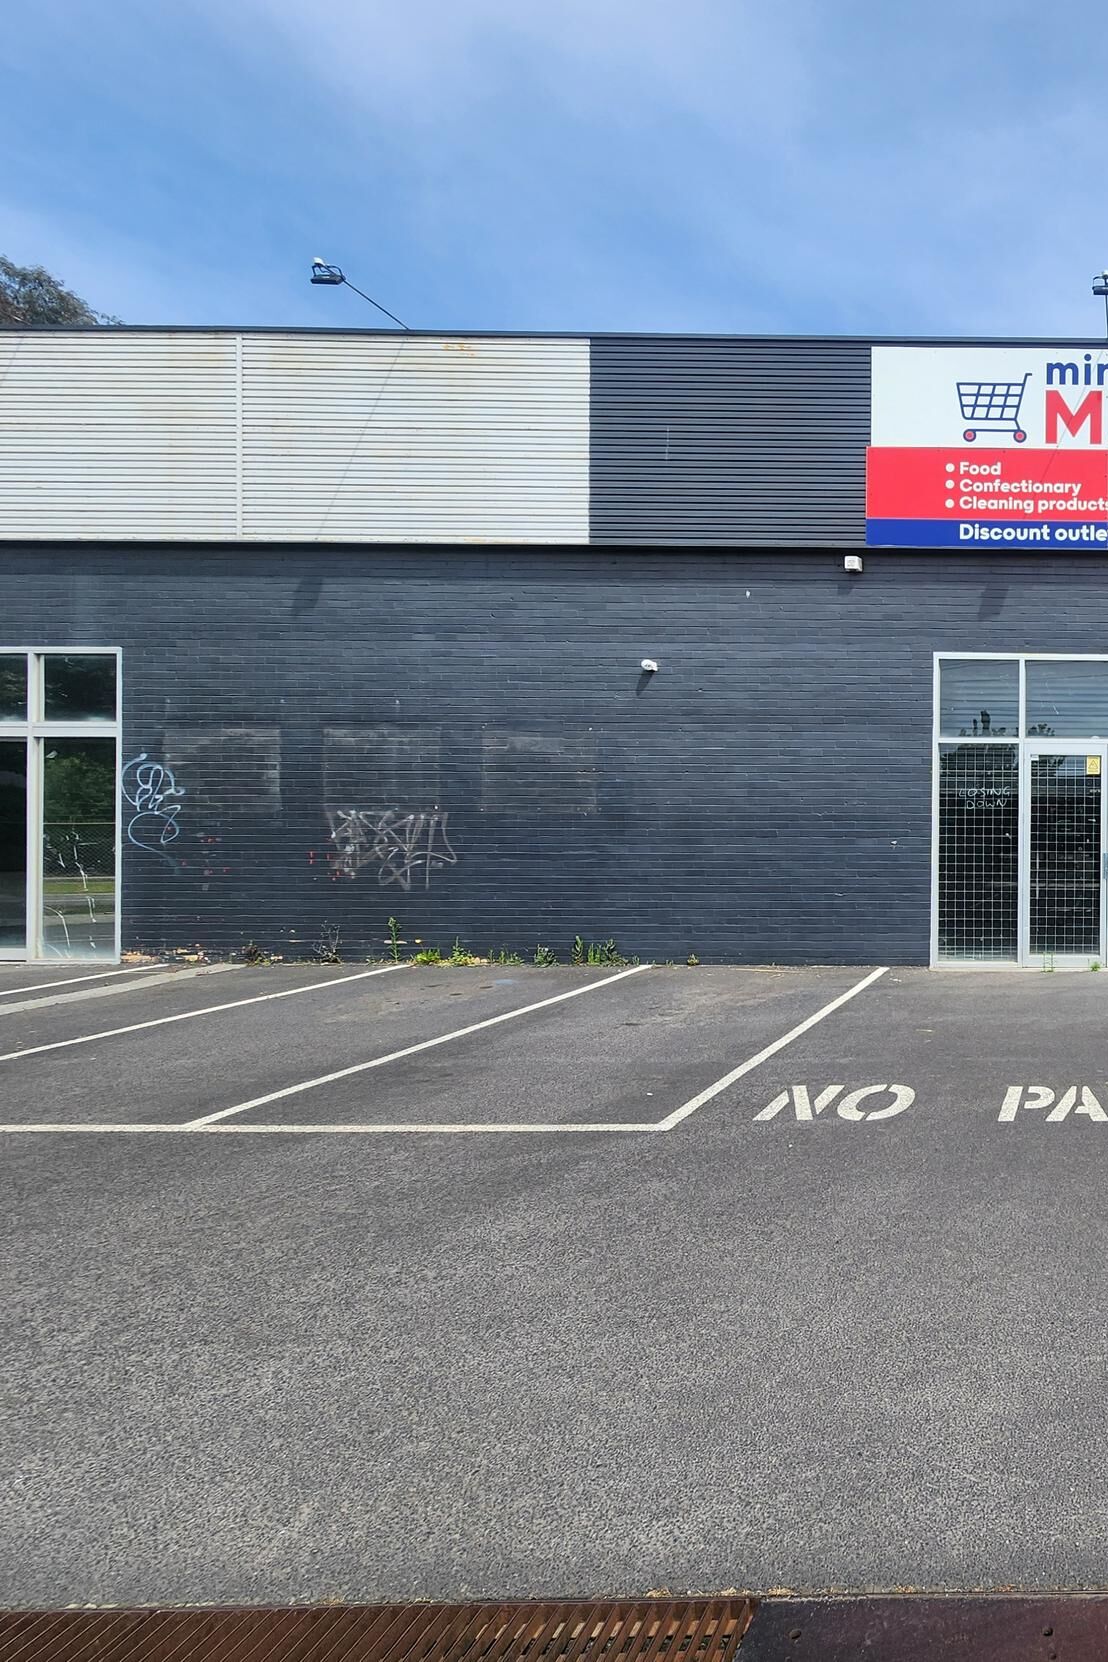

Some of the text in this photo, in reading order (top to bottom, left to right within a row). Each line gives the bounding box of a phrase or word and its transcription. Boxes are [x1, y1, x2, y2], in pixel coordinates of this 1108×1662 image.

[959, 461, 1002, 476] Food
[959, 478, 1082, 496] Confectionary
[959, 496, 1035, 514] Cleaning
[959, 523, 1050, 541] Discount
[966, 798, 1008, 810] DOWN
[752, 1084, 916, 1121] NO
